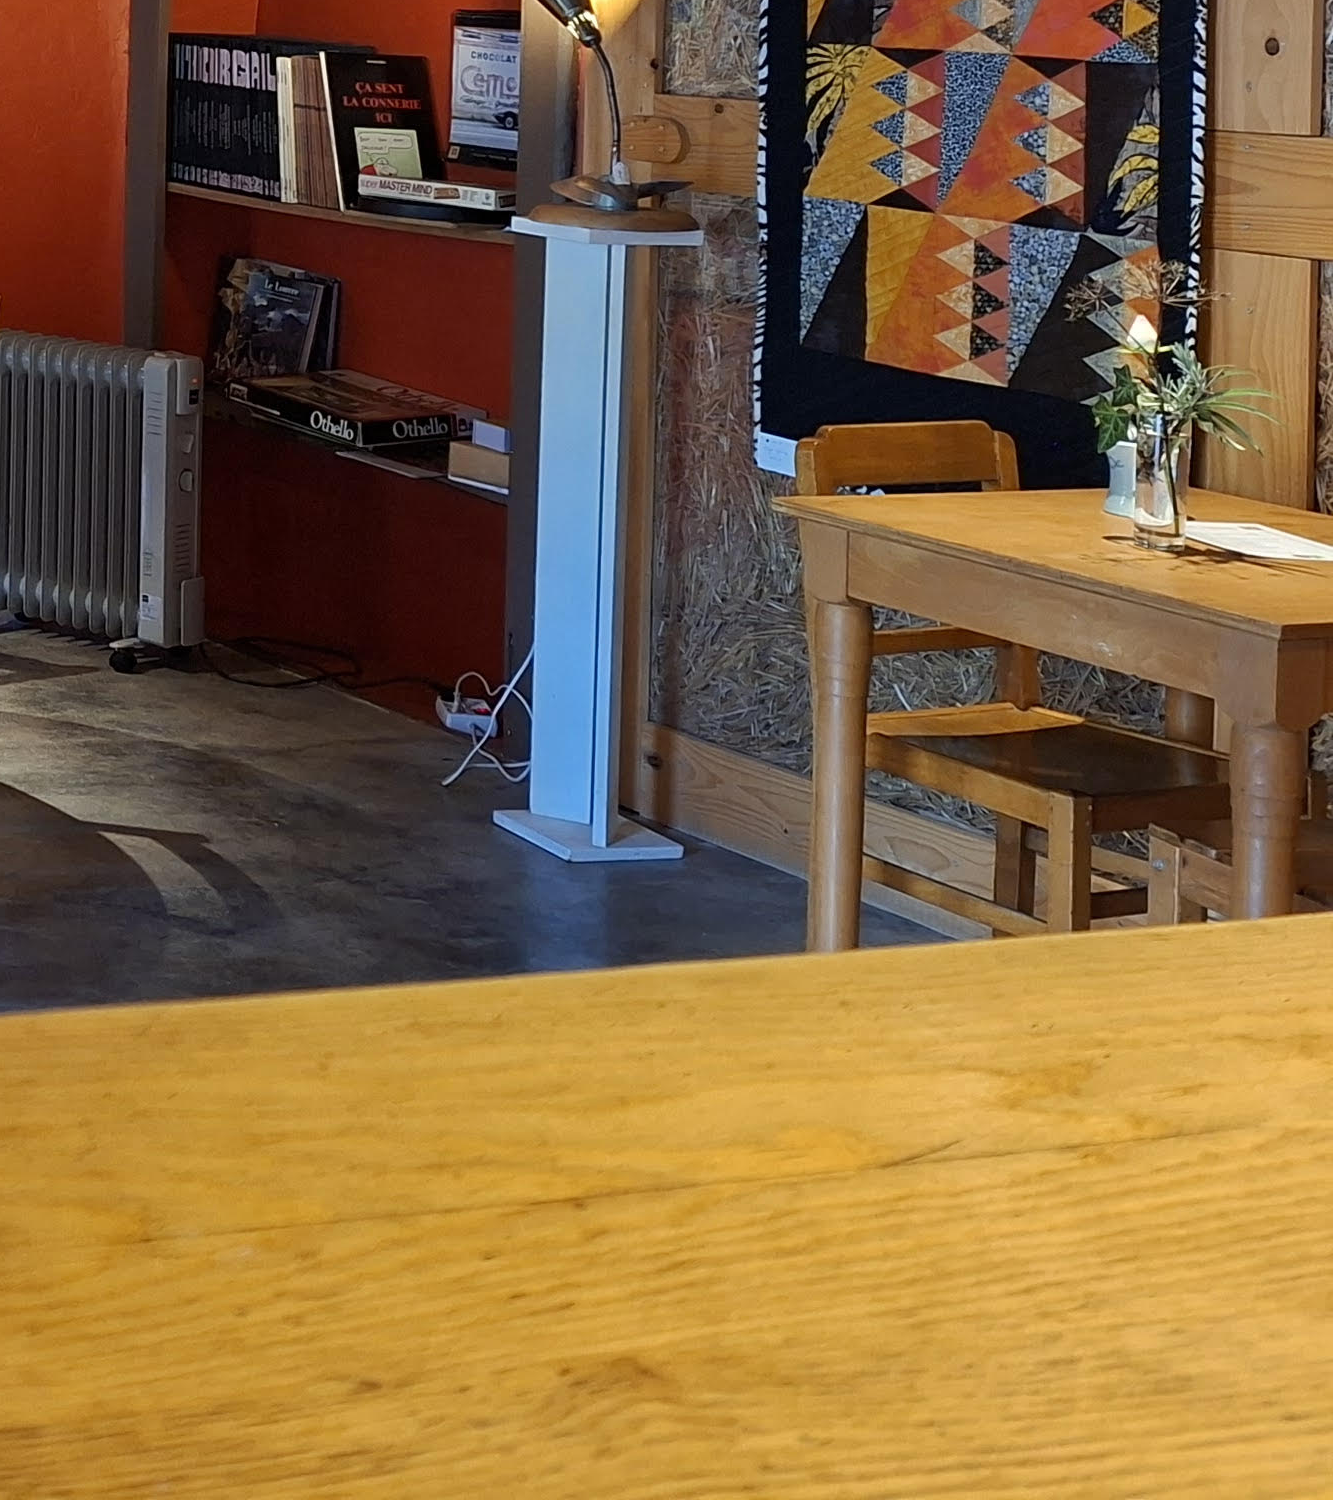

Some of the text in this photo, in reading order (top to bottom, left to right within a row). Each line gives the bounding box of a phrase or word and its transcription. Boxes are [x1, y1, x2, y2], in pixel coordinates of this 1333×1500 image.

[470, 50, 517, 63] CHOCOLAT
[374, 83, 404, 93] SENT
[342, 96, 421, 109] LA CONNERIE
[375, 113, 393, 123] ICI
[379, 180, 411, 192] MASTER
[412, 183, 432, 194] MIND
[310, 410, 354, 441] Othello
[392, 417, 448, 439] Othello
